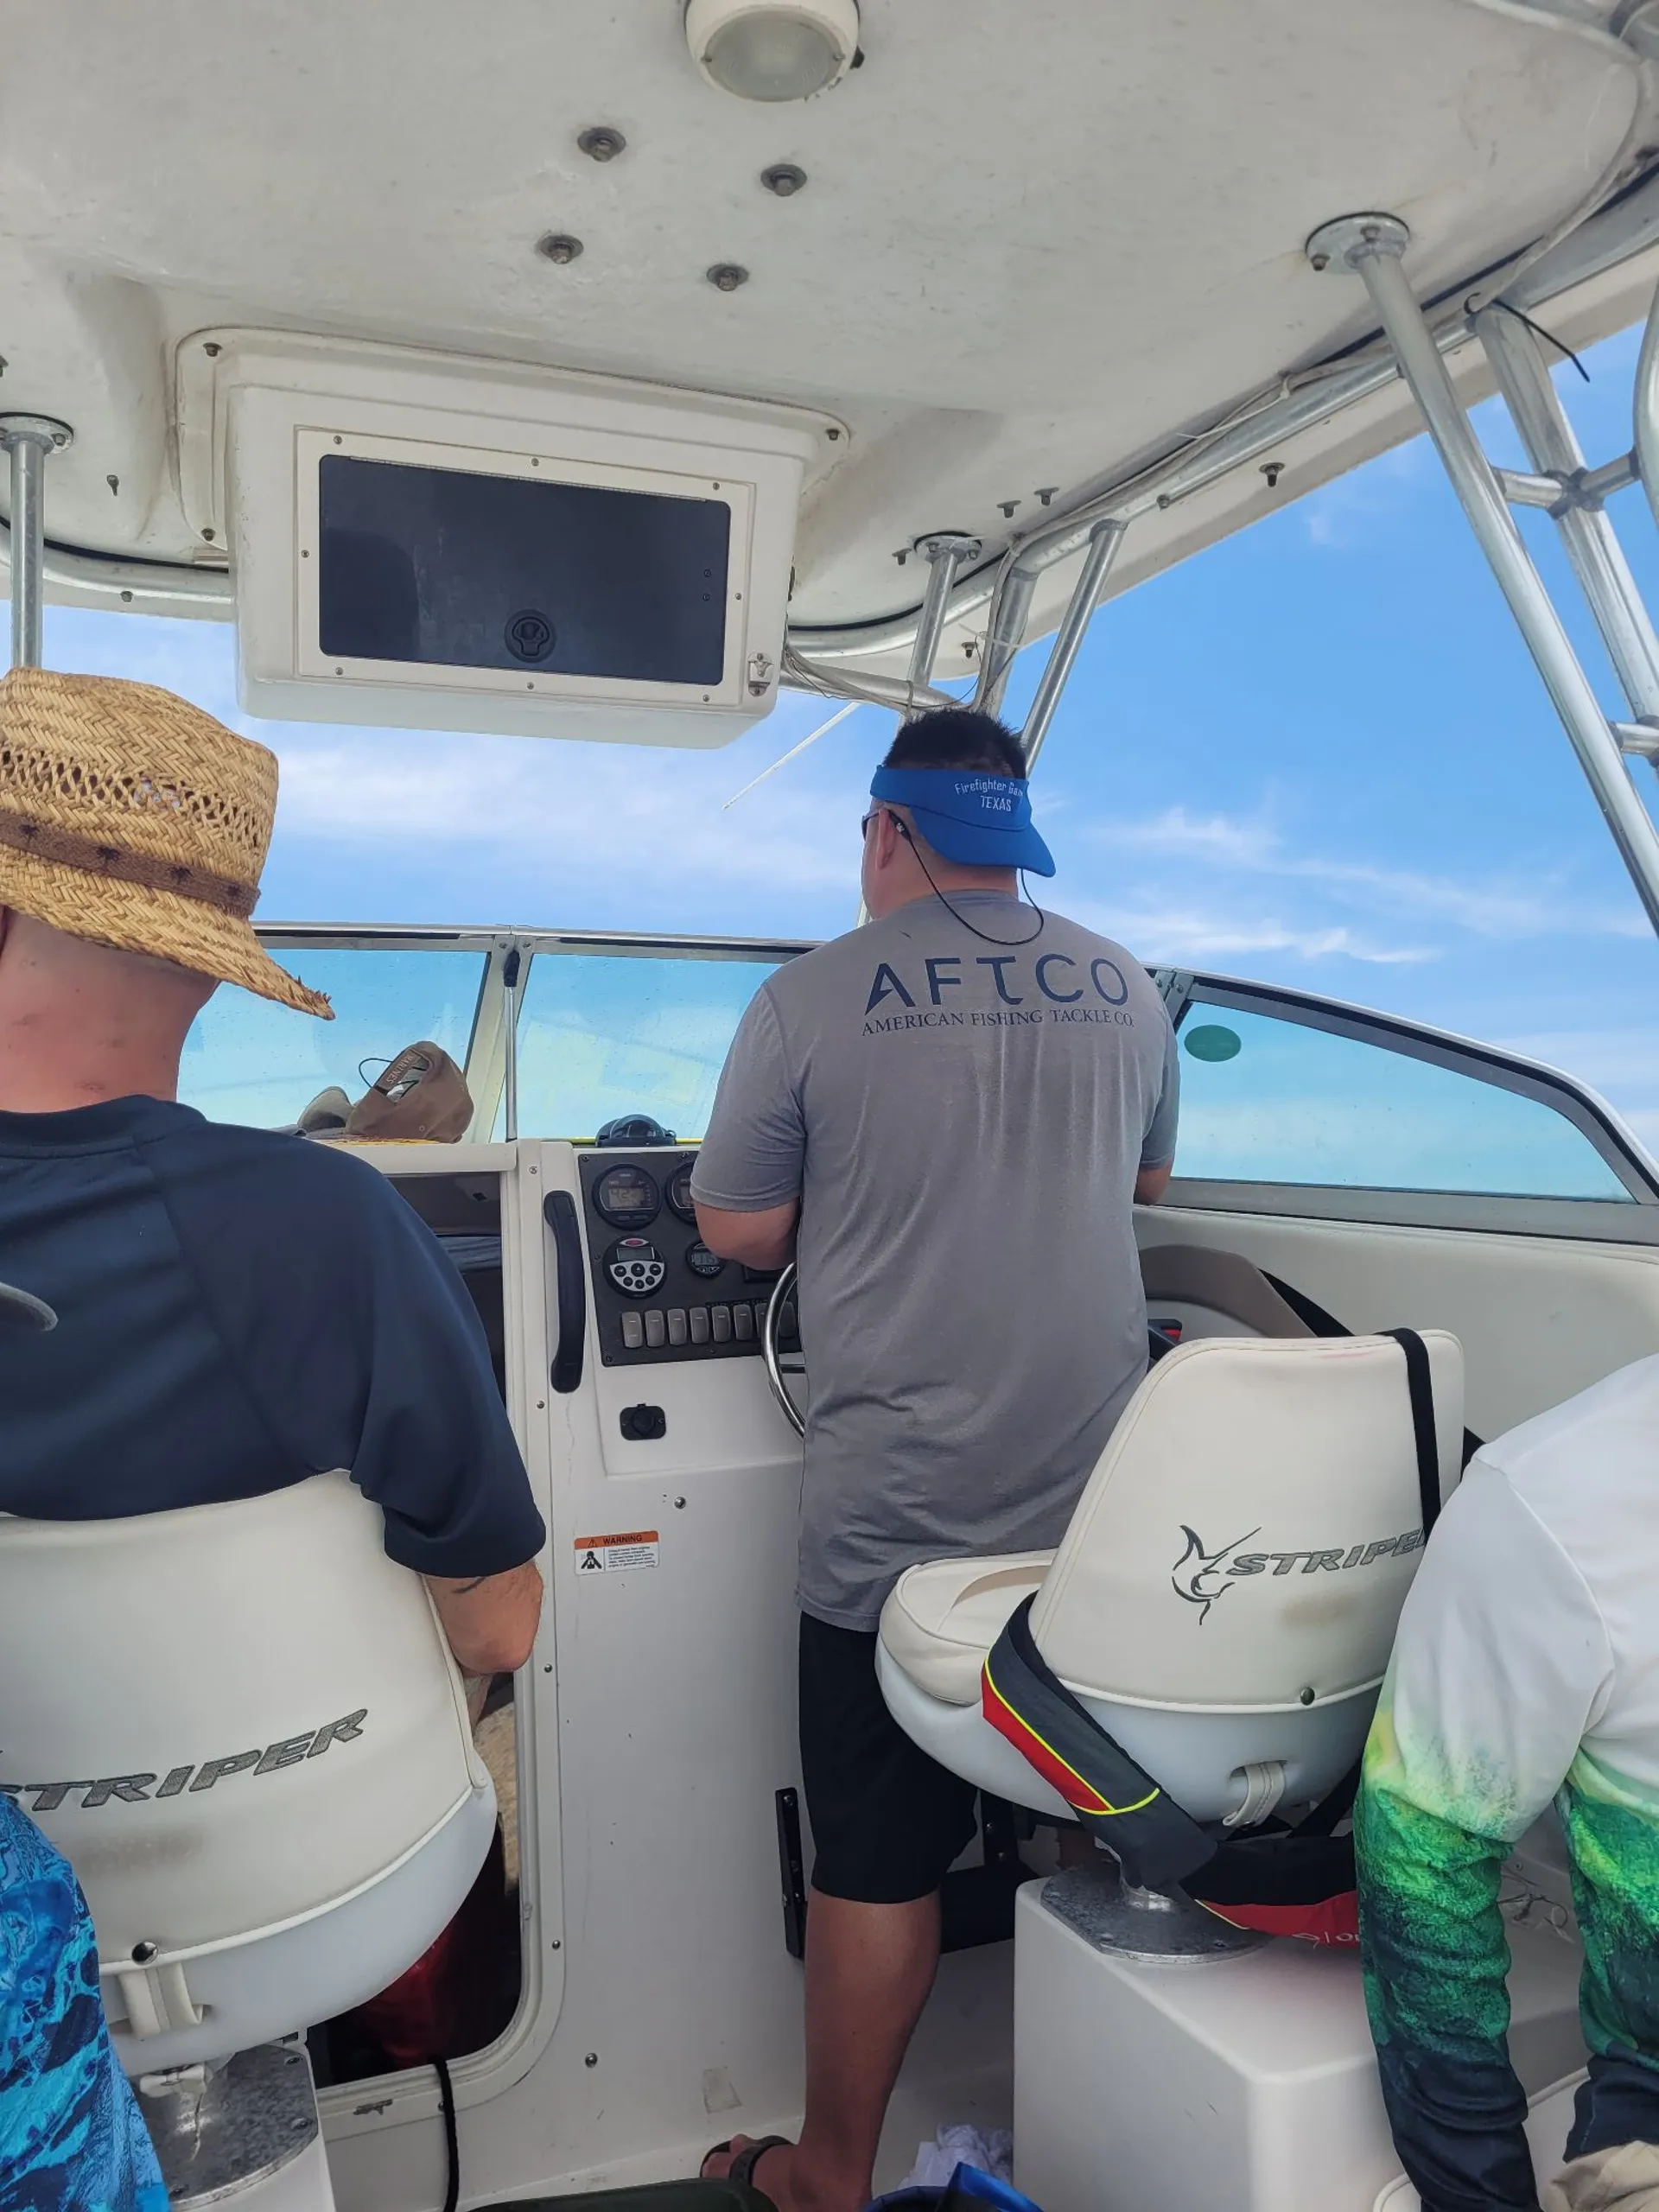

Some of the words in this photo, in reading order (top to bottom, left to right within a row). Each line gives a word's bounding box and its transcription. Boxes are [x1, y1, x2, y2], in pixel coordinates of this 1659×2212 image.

[954, 779, 1007, 795] Firefighter
[980, 795, 1012, 812] TEXAS
[865, 953, 1128, 1015] AFTCO
[862, 1012, 963, 1036] AMERICAN
[971, 1009, 1043, 1027] FISHING
[1050, 1008, 1112, 1023] TACKLE
[1114, 1011, 1135, 1027] CO.
[603, 1535, 642, 1545] WARNING
